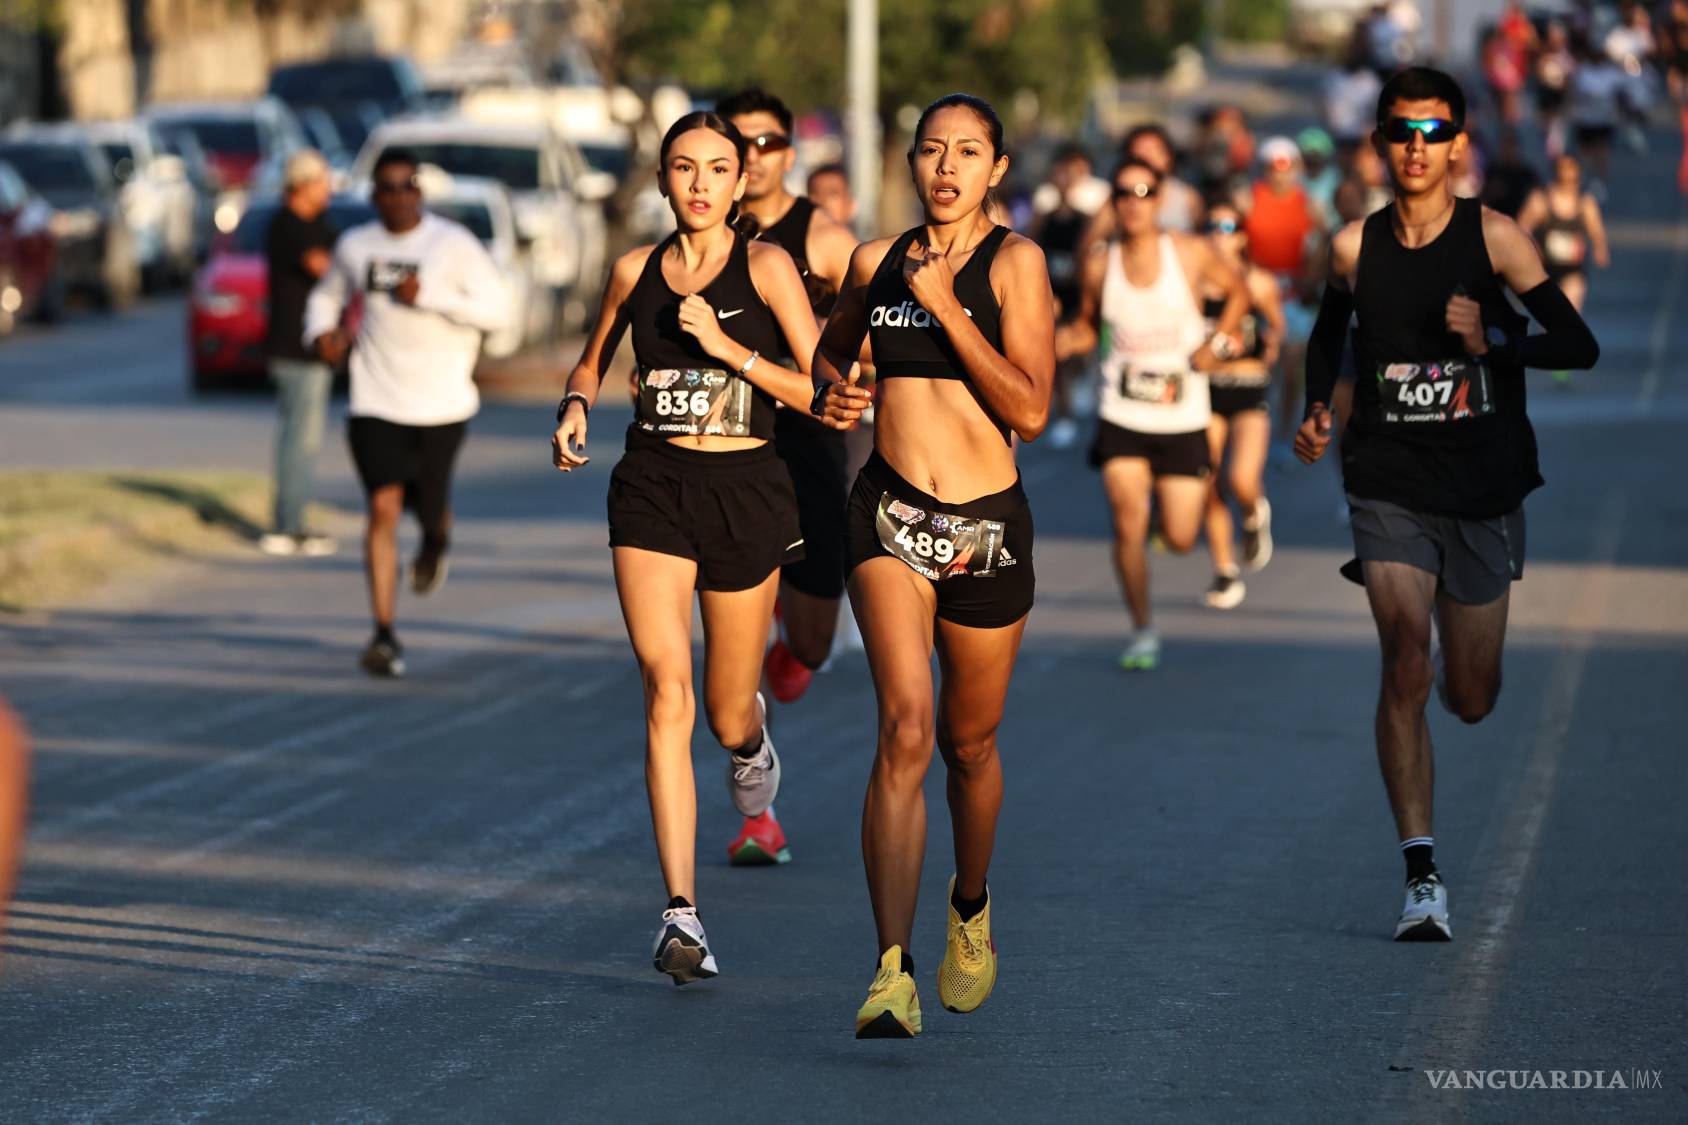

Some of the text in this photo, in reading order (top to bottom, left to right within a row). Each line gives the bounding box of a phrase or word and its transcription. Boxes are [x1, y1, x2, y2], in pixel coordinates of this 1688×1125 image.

[656, 390, 710, 416] 836
[1398, 380, 1454, 407] 407
[894, 525, 955, 564] 489
